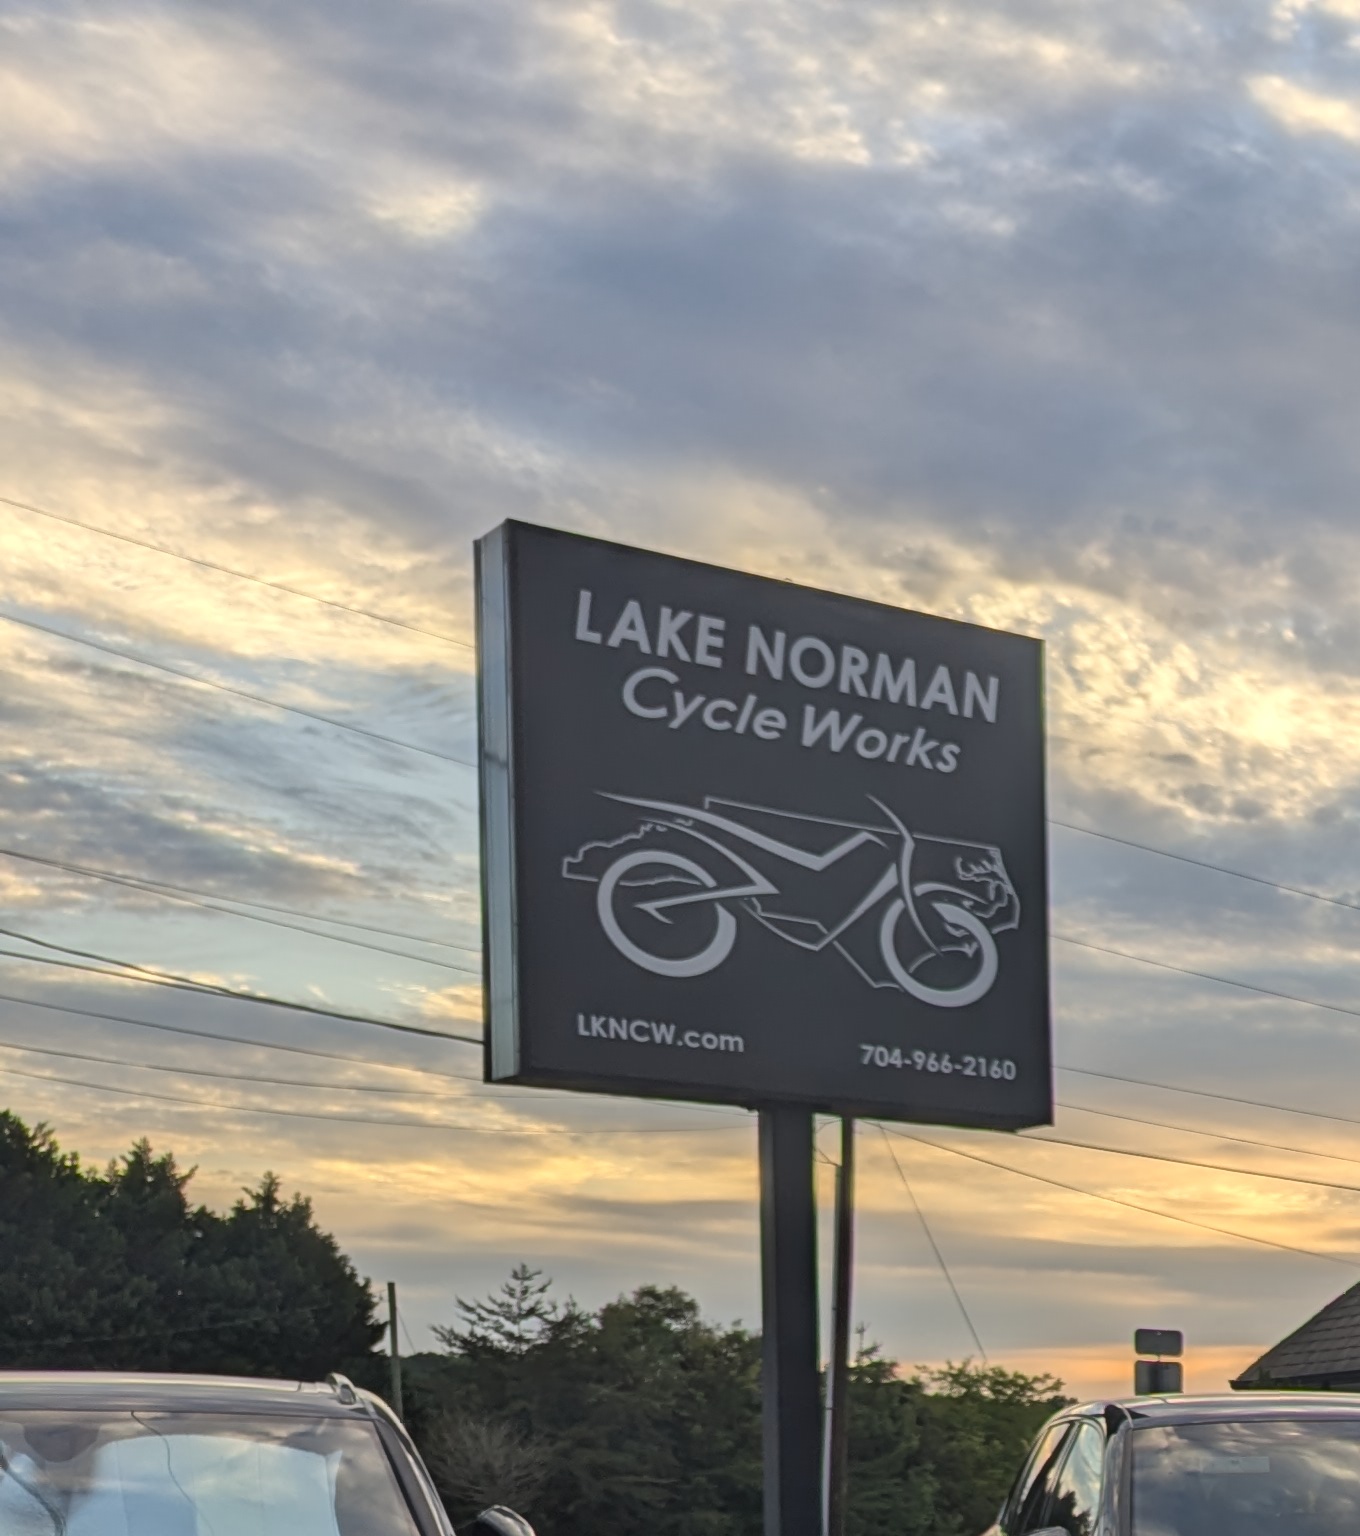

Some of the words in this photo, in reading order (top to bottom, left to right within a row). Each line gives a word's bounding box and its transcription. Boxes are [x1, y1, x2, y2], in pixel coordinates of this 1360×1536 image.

[575, 589, 726, 670] LAKE
[745, 624, 999, 724] NORMAN
[622, 667, 787, 741] Cycle
[801, 704, 962, 774] Works
[576, 1012, 745, 1054] LKNCW.com
[859, 1043, 1017, 1081] 704-966-2160
